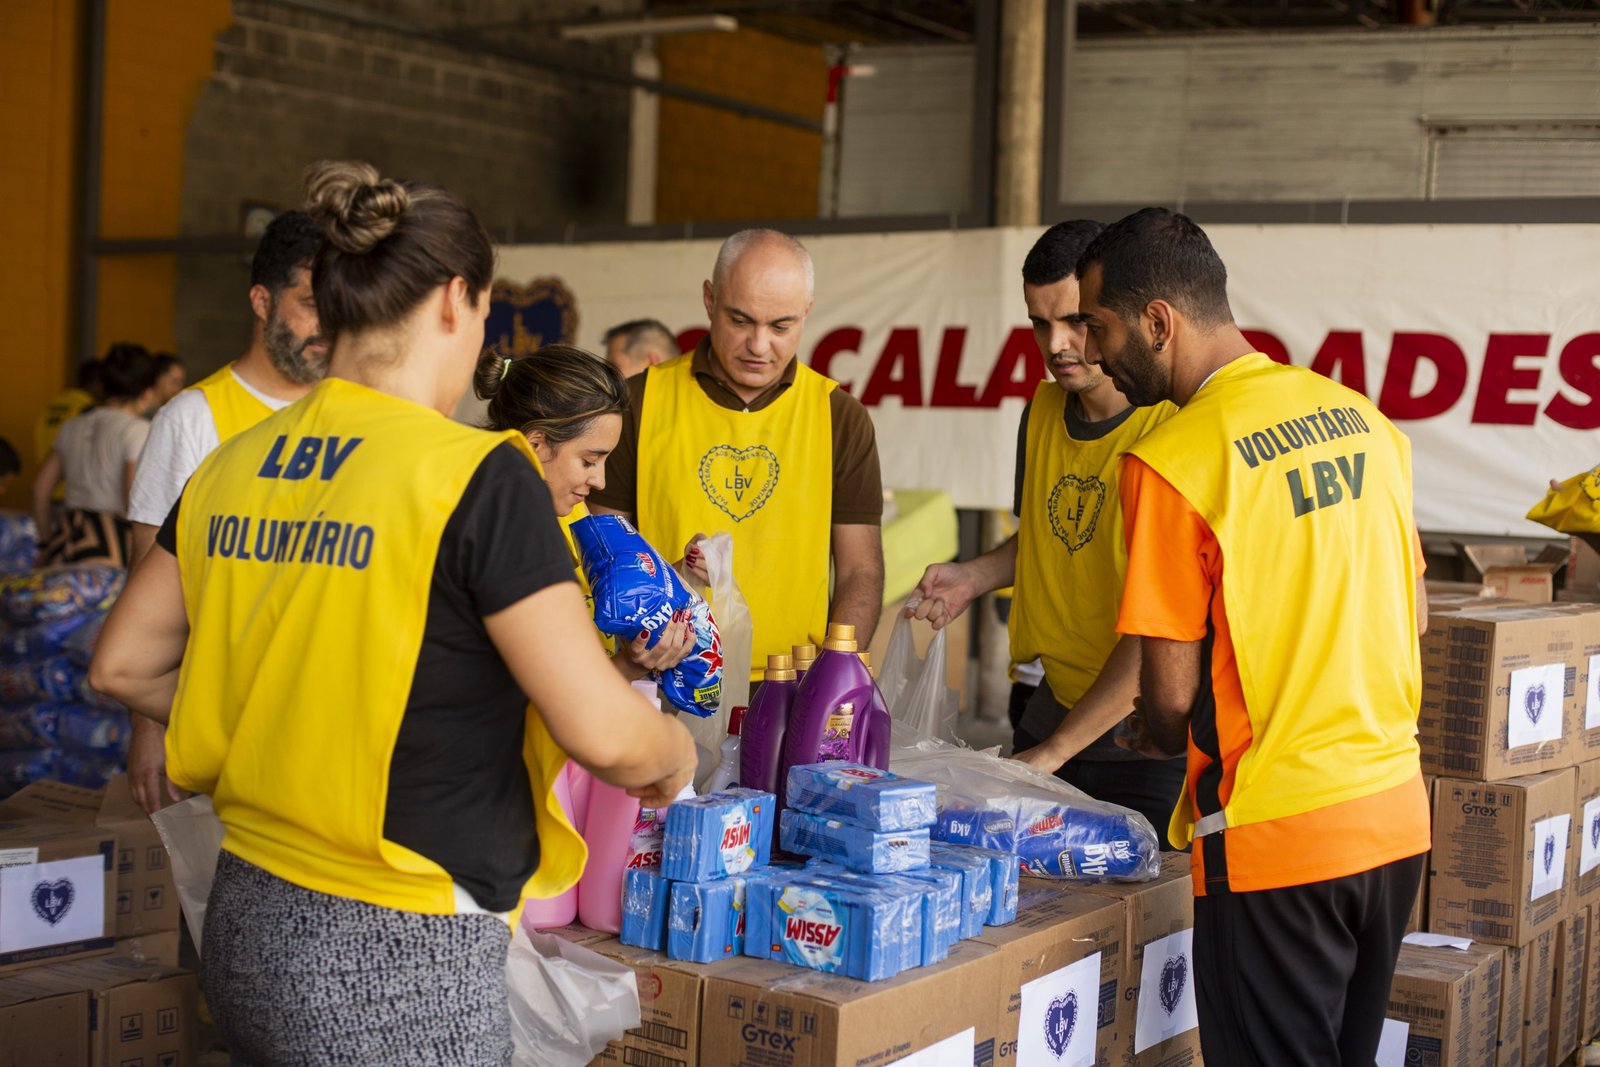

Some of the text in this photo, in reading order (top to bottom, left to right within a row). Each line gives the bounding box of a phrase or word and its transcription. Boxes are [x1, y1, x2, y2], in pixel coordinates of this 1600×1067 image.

[811, 325, 1600, 430] CALAADES
[256, 434, 365, 481] LBV
[1233, 406, 1370, 469] VOLUNTÁRIO
[730, 451, 760, 461] HOMENS
[750, 480, 771, 507] VONTADE
[1286, 452, 1365, 518] LBV
[207, 511, 375, 570] VOLUNTÁRIO
[641, 602, 673, 631] 4kg
[720, 821, 752, 851] ASSIM
[950, 820, 970, 837] 4kg
[628, 850, 662, 869] ASS
[1080, 843, 1109, 876] 4kg
[786, 917, 842, 948] ASSIM
